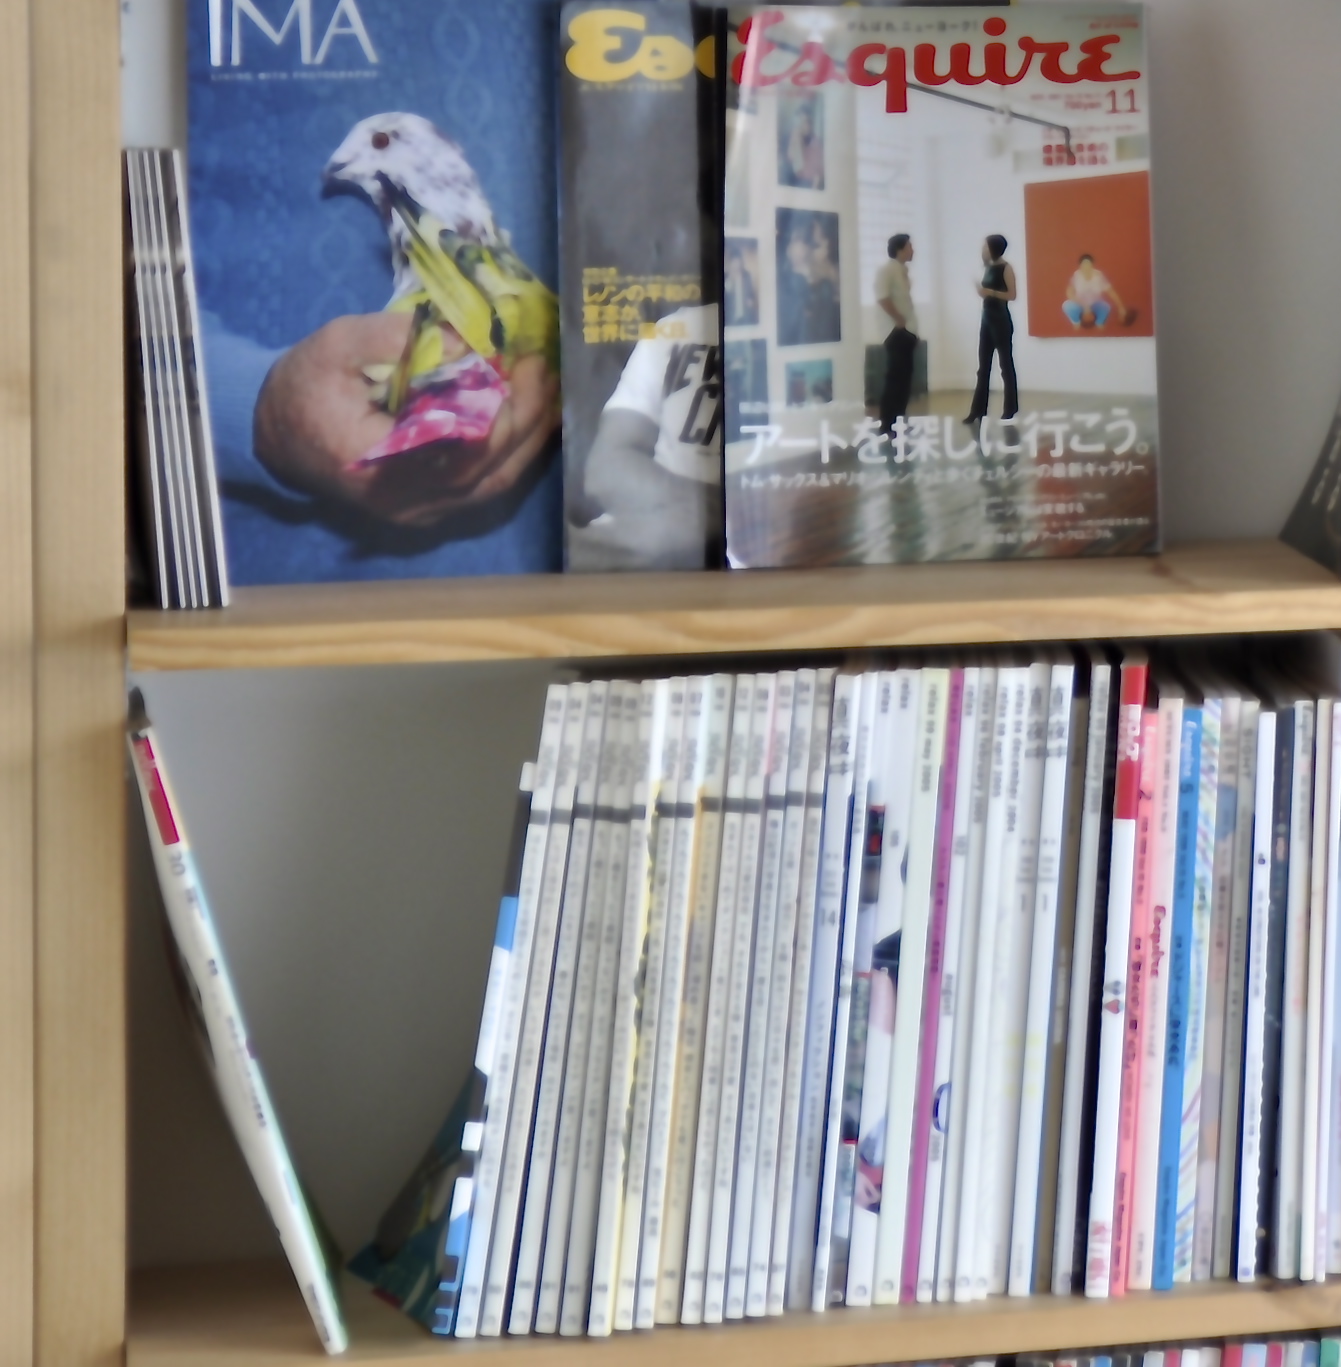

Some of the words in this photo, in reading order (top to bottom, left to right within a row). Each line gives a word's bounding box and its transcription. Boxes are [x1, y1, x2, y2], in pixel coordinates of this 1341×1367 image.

[731, 11, 1141, 114] Esquire
[1105, 88, 1139, 115] 11
[740, 408, 1150, 465] アートを探しに行こう。
